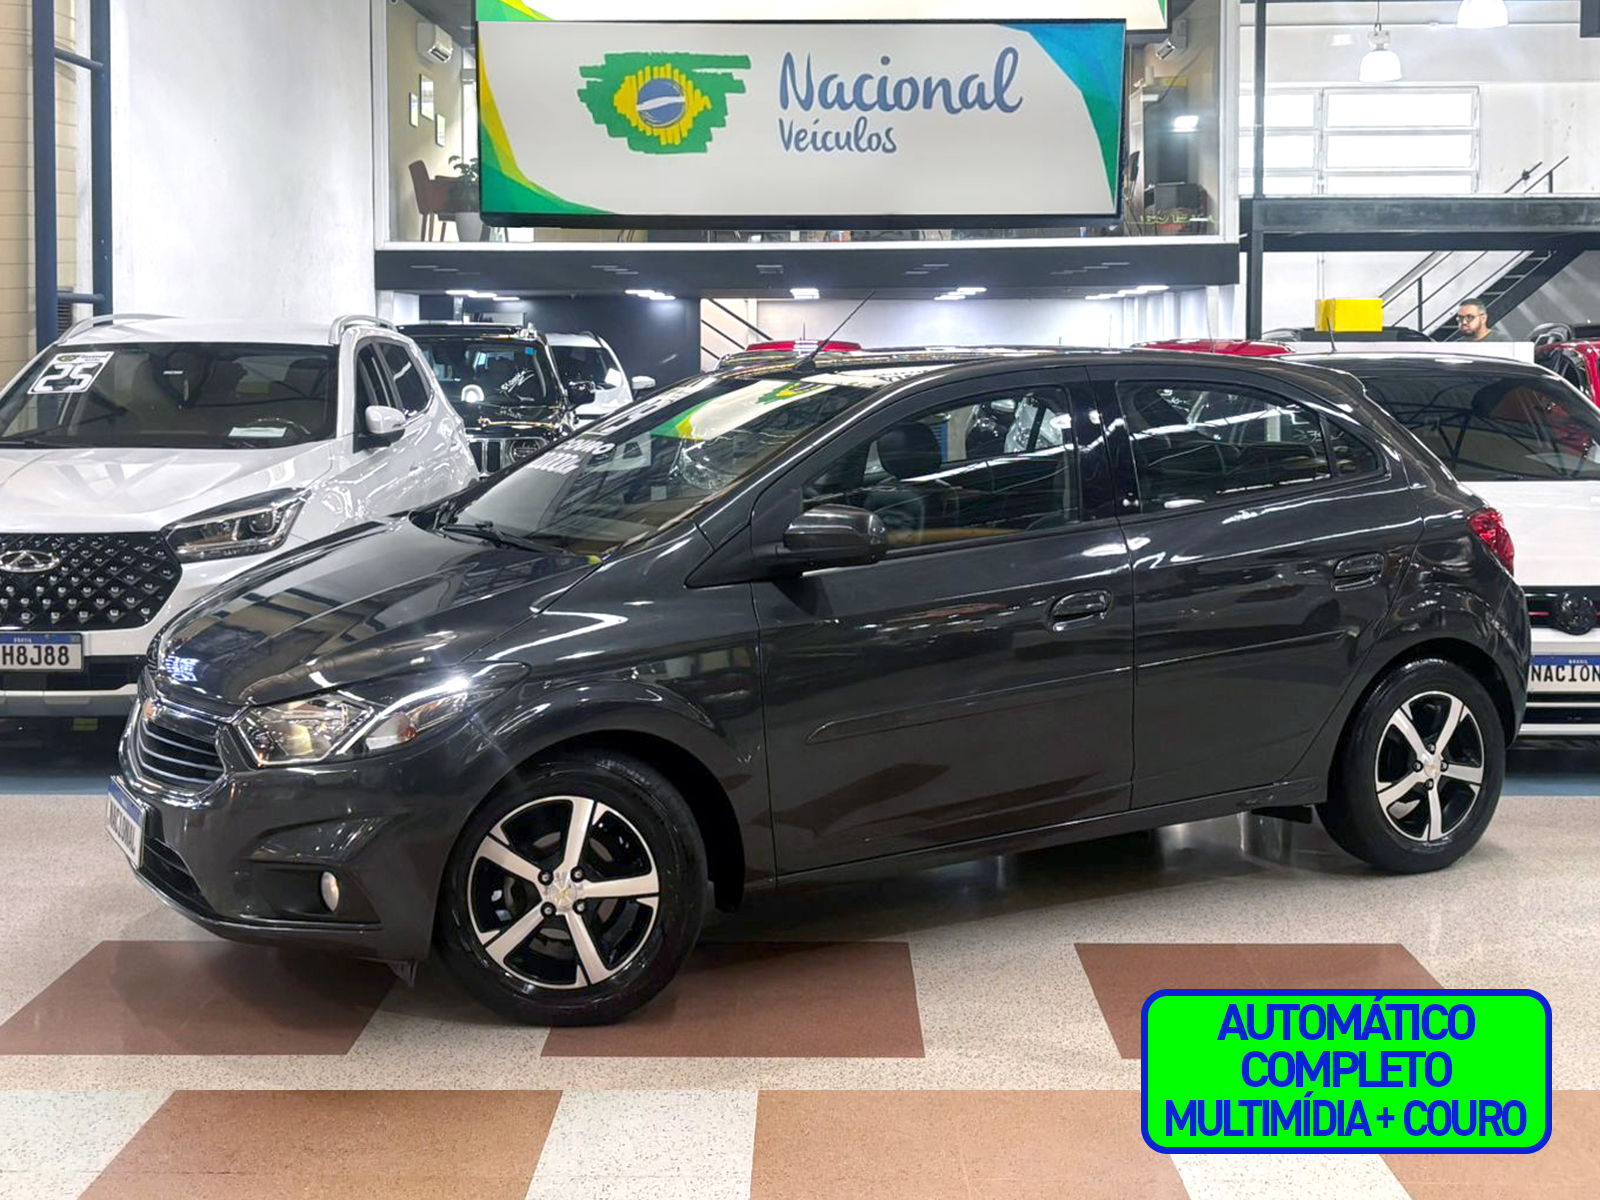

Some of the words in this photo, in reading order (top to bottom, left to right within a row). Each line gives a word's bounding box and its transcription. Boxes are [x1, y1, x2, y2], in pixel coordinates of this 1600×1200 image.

[779, 46, 1023, 115] Nacional
[778, 116, 897, 153] Veículos
[33, 362, 100, 392] 25
[2, 645, 70, 666] H8J88
